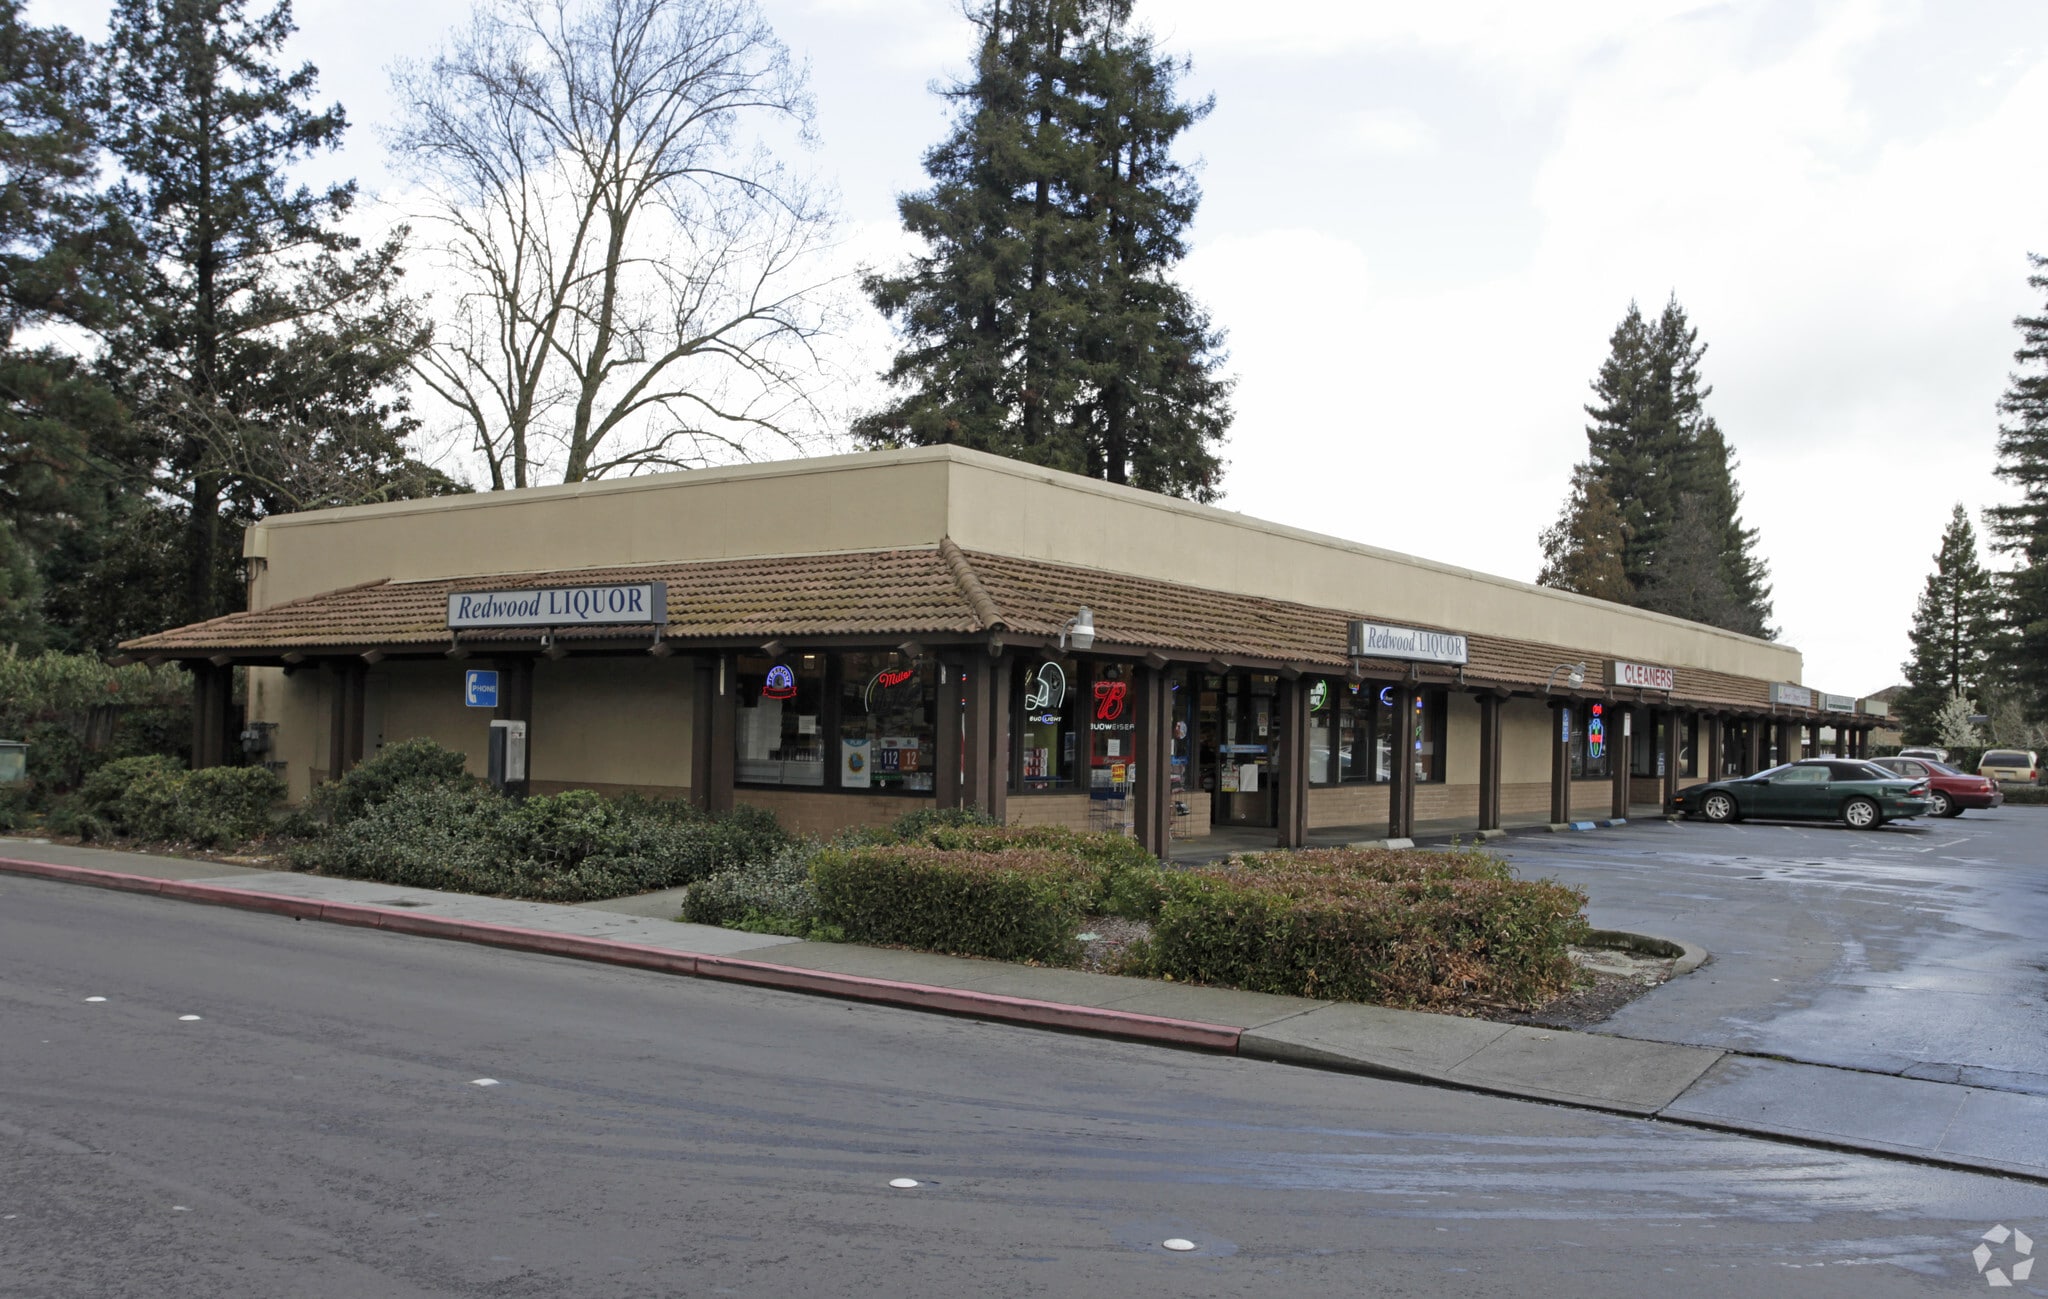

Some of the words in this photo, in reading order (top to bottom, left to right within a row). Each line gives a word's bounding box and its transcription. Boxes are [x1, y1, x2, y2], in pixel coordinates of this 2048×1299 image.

[457, 591, 542, 619] Redwood
[549, 588, 643, 619] LIQUOR
[1368, 627, 1416, 652] Redwood
[1419, 632, 1463, 658] LIQUOR
[879, 669, 914, 688] Miller
[1624, 664, 1672, 688] CLEANERS
[472, 685, 496, 693] PHONE
[883, 751, 898, 765] 112
[906, 751, 917, 765] 12
